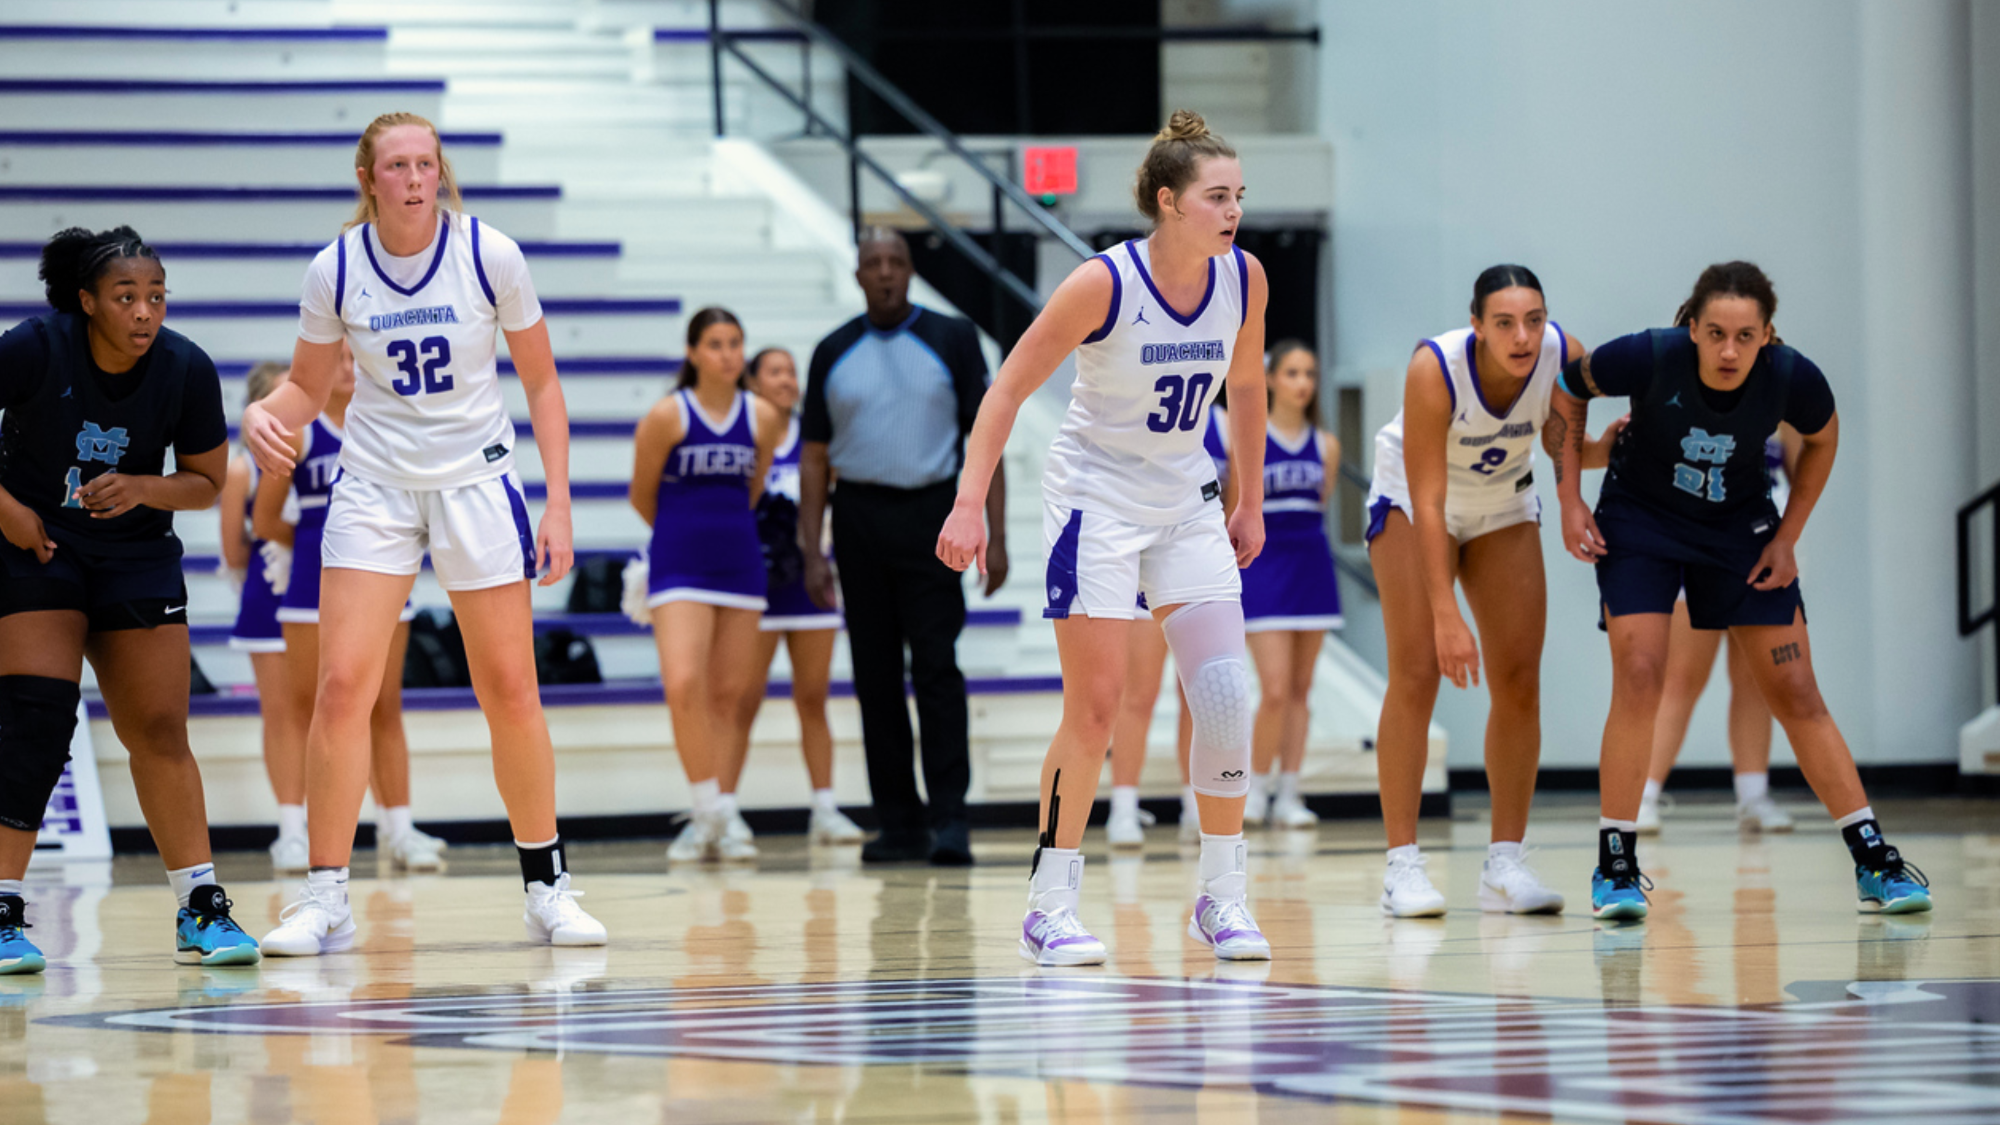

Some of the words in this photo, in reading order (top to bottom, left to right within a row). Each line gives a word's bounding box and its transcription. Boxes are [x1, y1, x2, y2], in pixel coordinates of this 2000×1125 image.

[369, 304, 460, 332] OUACHITA
[386, 335, 454, 396] 32
[1140, 340, 1225, 365] OUACHITA
[1146, 373, 1213, 433] 30
